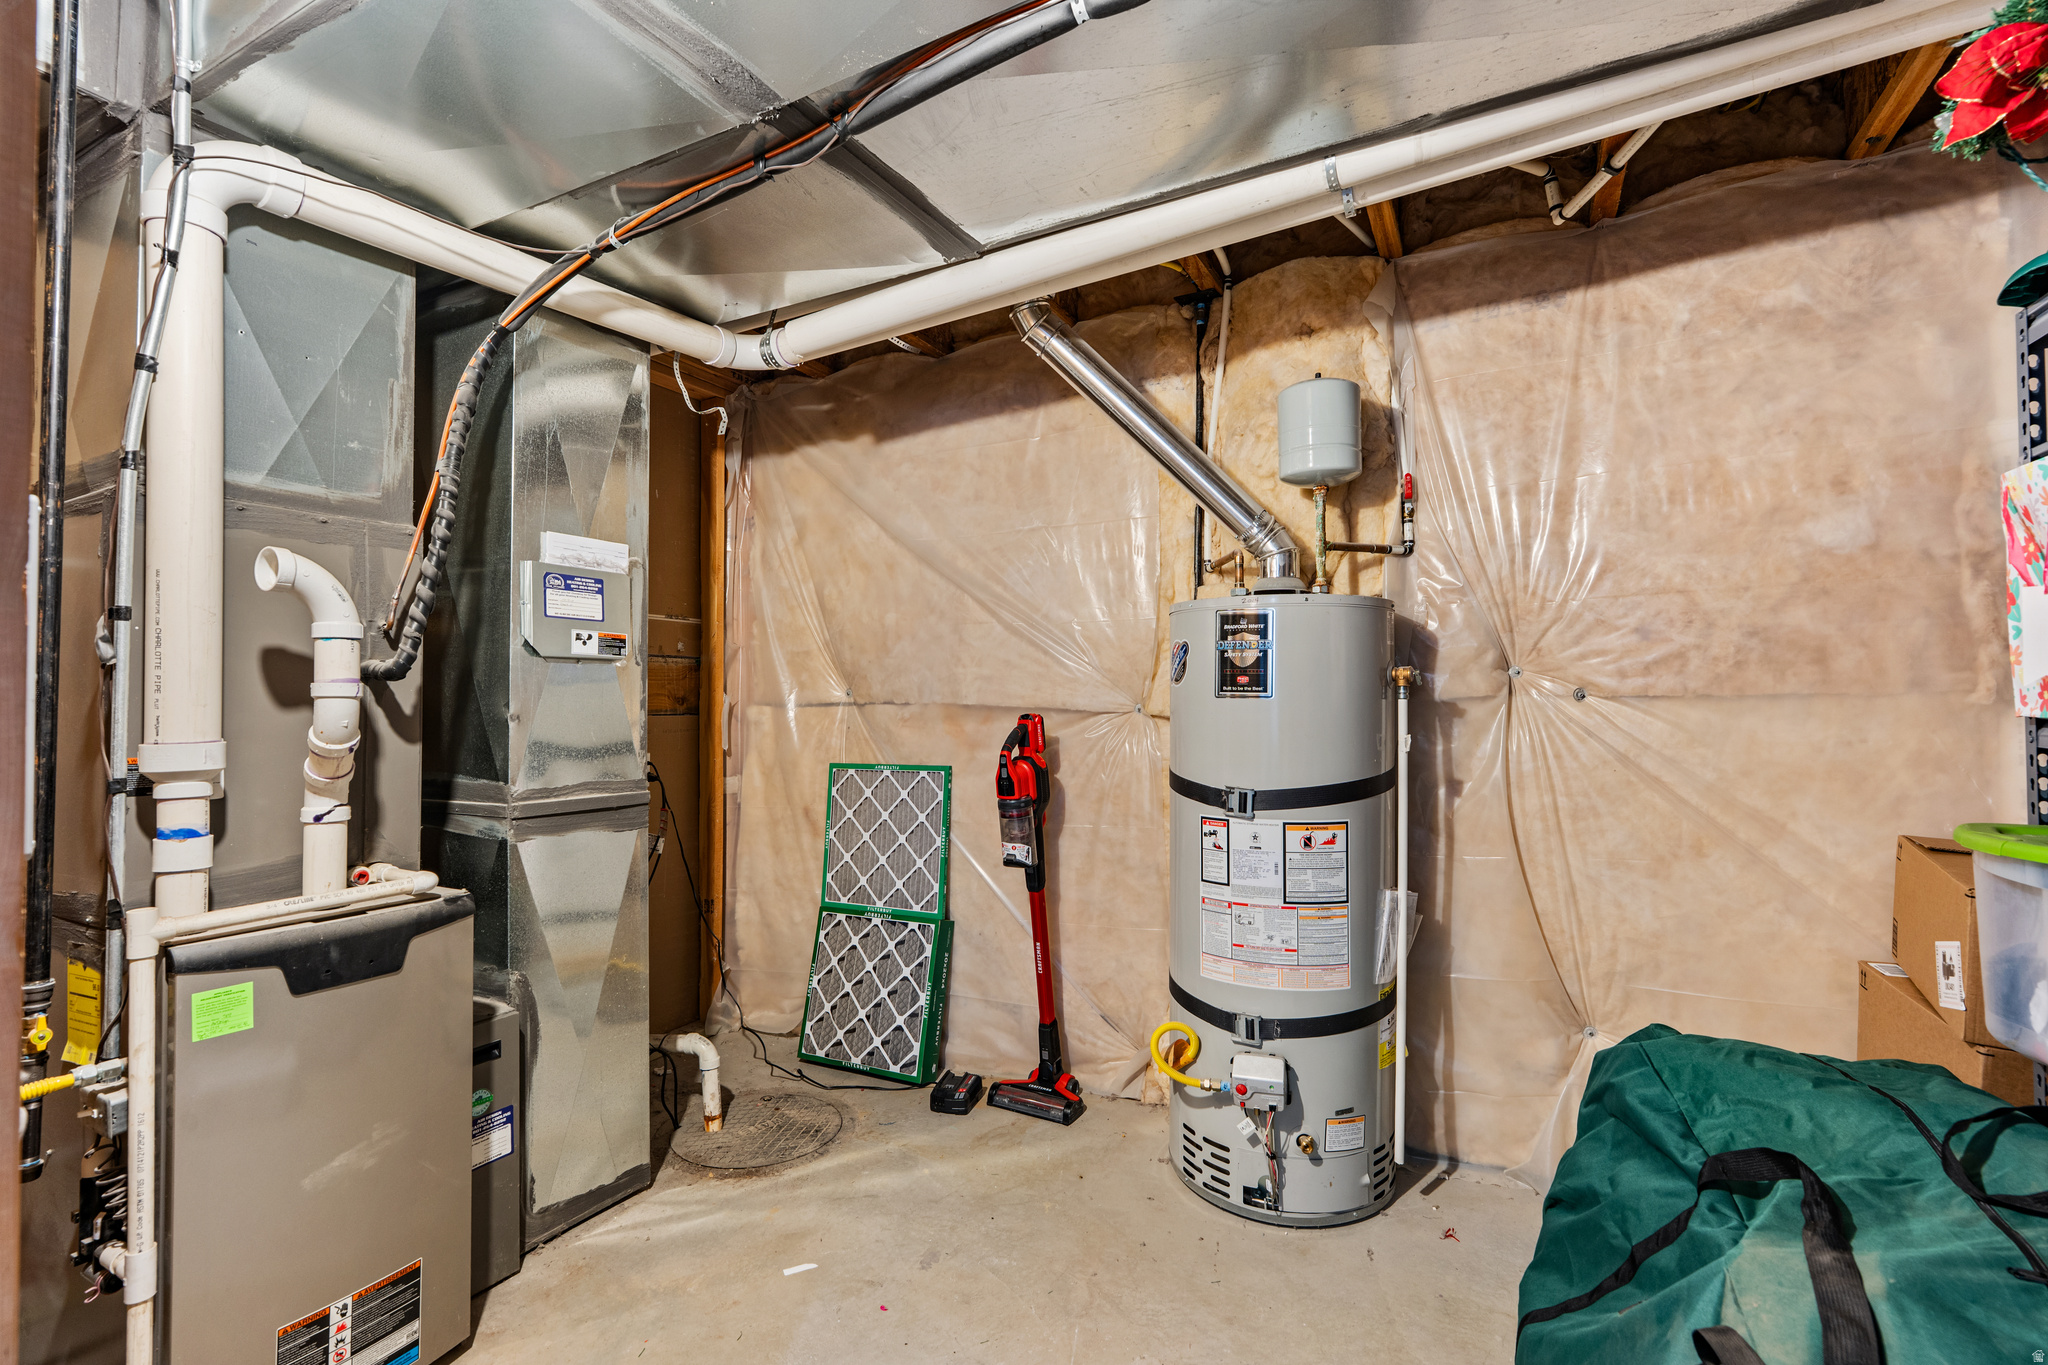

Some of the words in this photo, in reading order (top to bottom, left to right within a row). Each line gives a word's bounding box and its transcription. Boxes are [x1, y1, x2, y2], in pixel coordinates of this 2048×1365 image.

[1217, 640, 1273, 650] DEFENDER
[842, 1062, 870, 1071] FILTERBUY
[1028, 1084, 1052, 1092] CRAFTSMAN
[363, 1262, 418, 1295] AVERTISSEMENT
[290, 1310, 327, 1331] WARNING
